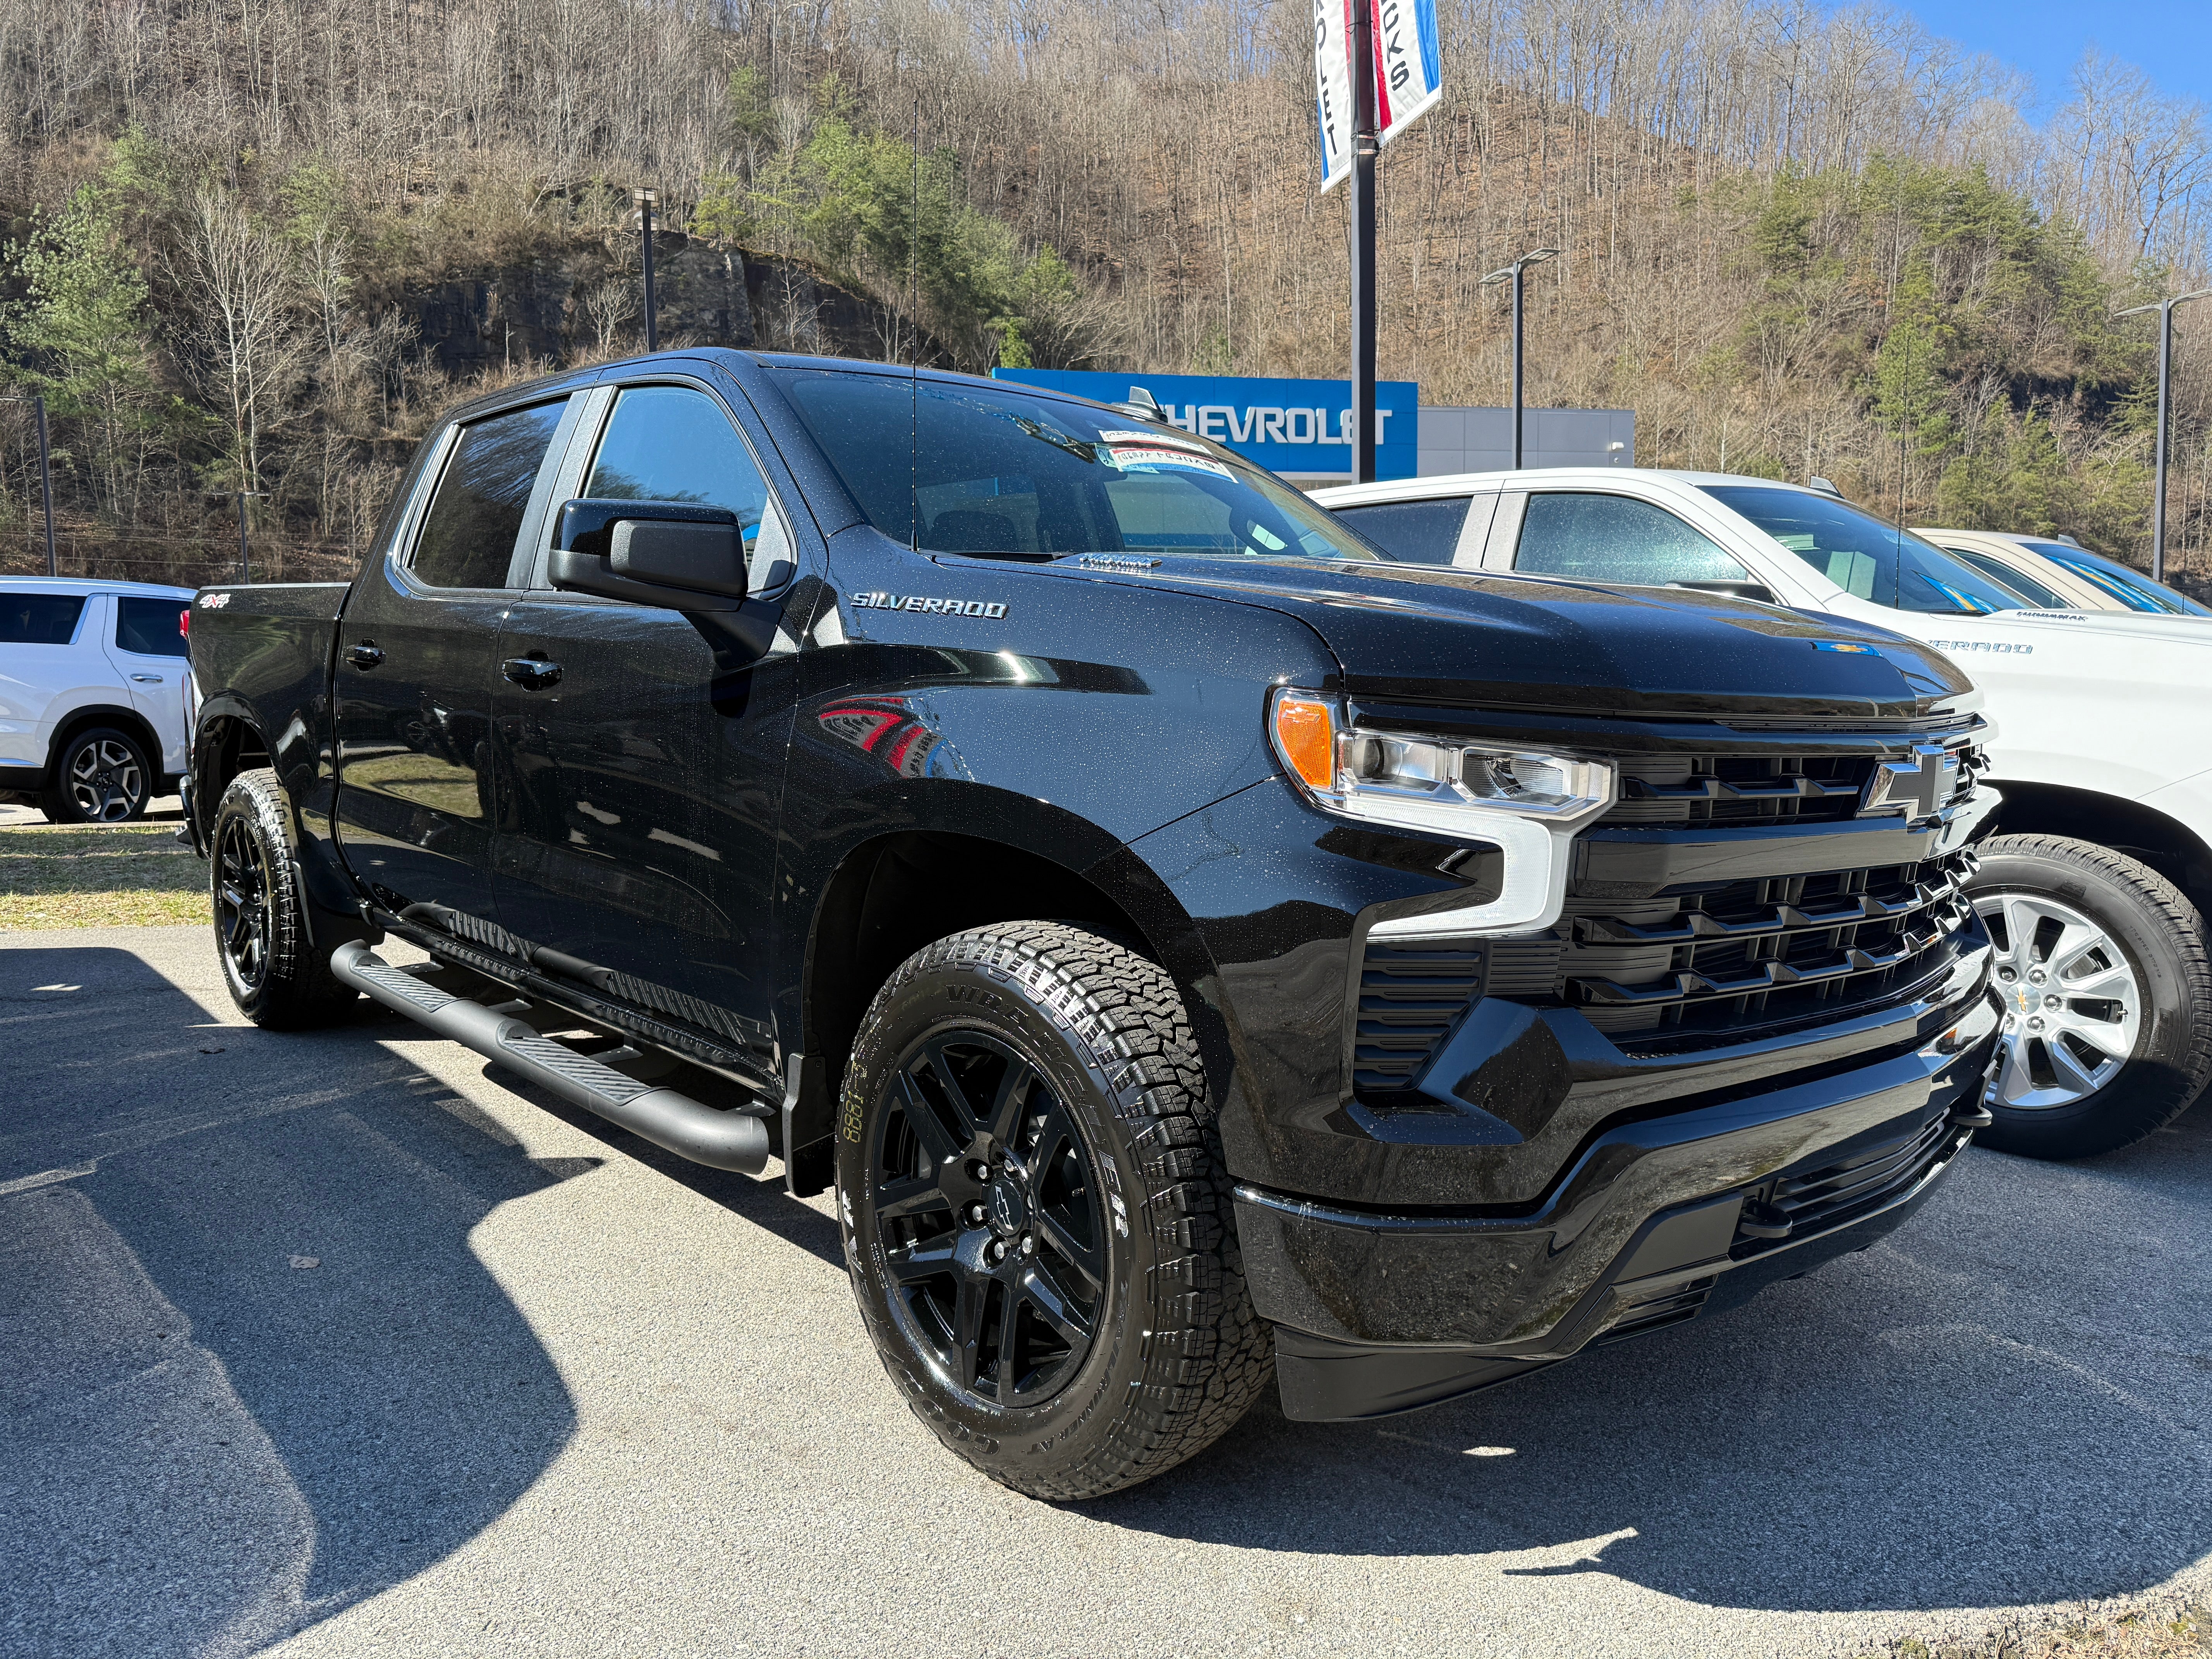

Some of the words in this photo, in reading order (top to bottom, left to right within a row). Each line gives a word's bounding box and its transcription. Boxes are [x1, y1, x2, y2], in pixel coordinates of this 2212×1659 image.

[1381, 0, 1409, 91] CKS
[1316, 0, 1337, 155] OLET
[1159, 405, 1393, 445] HEVROLT
[199, 594, 231, 608] 4X4
[850, 592, 1009, 619] SILVERADO
[1927, 640, 2033, 654] ERADO
[943, 984, 1129, 1238] WRANGLER
